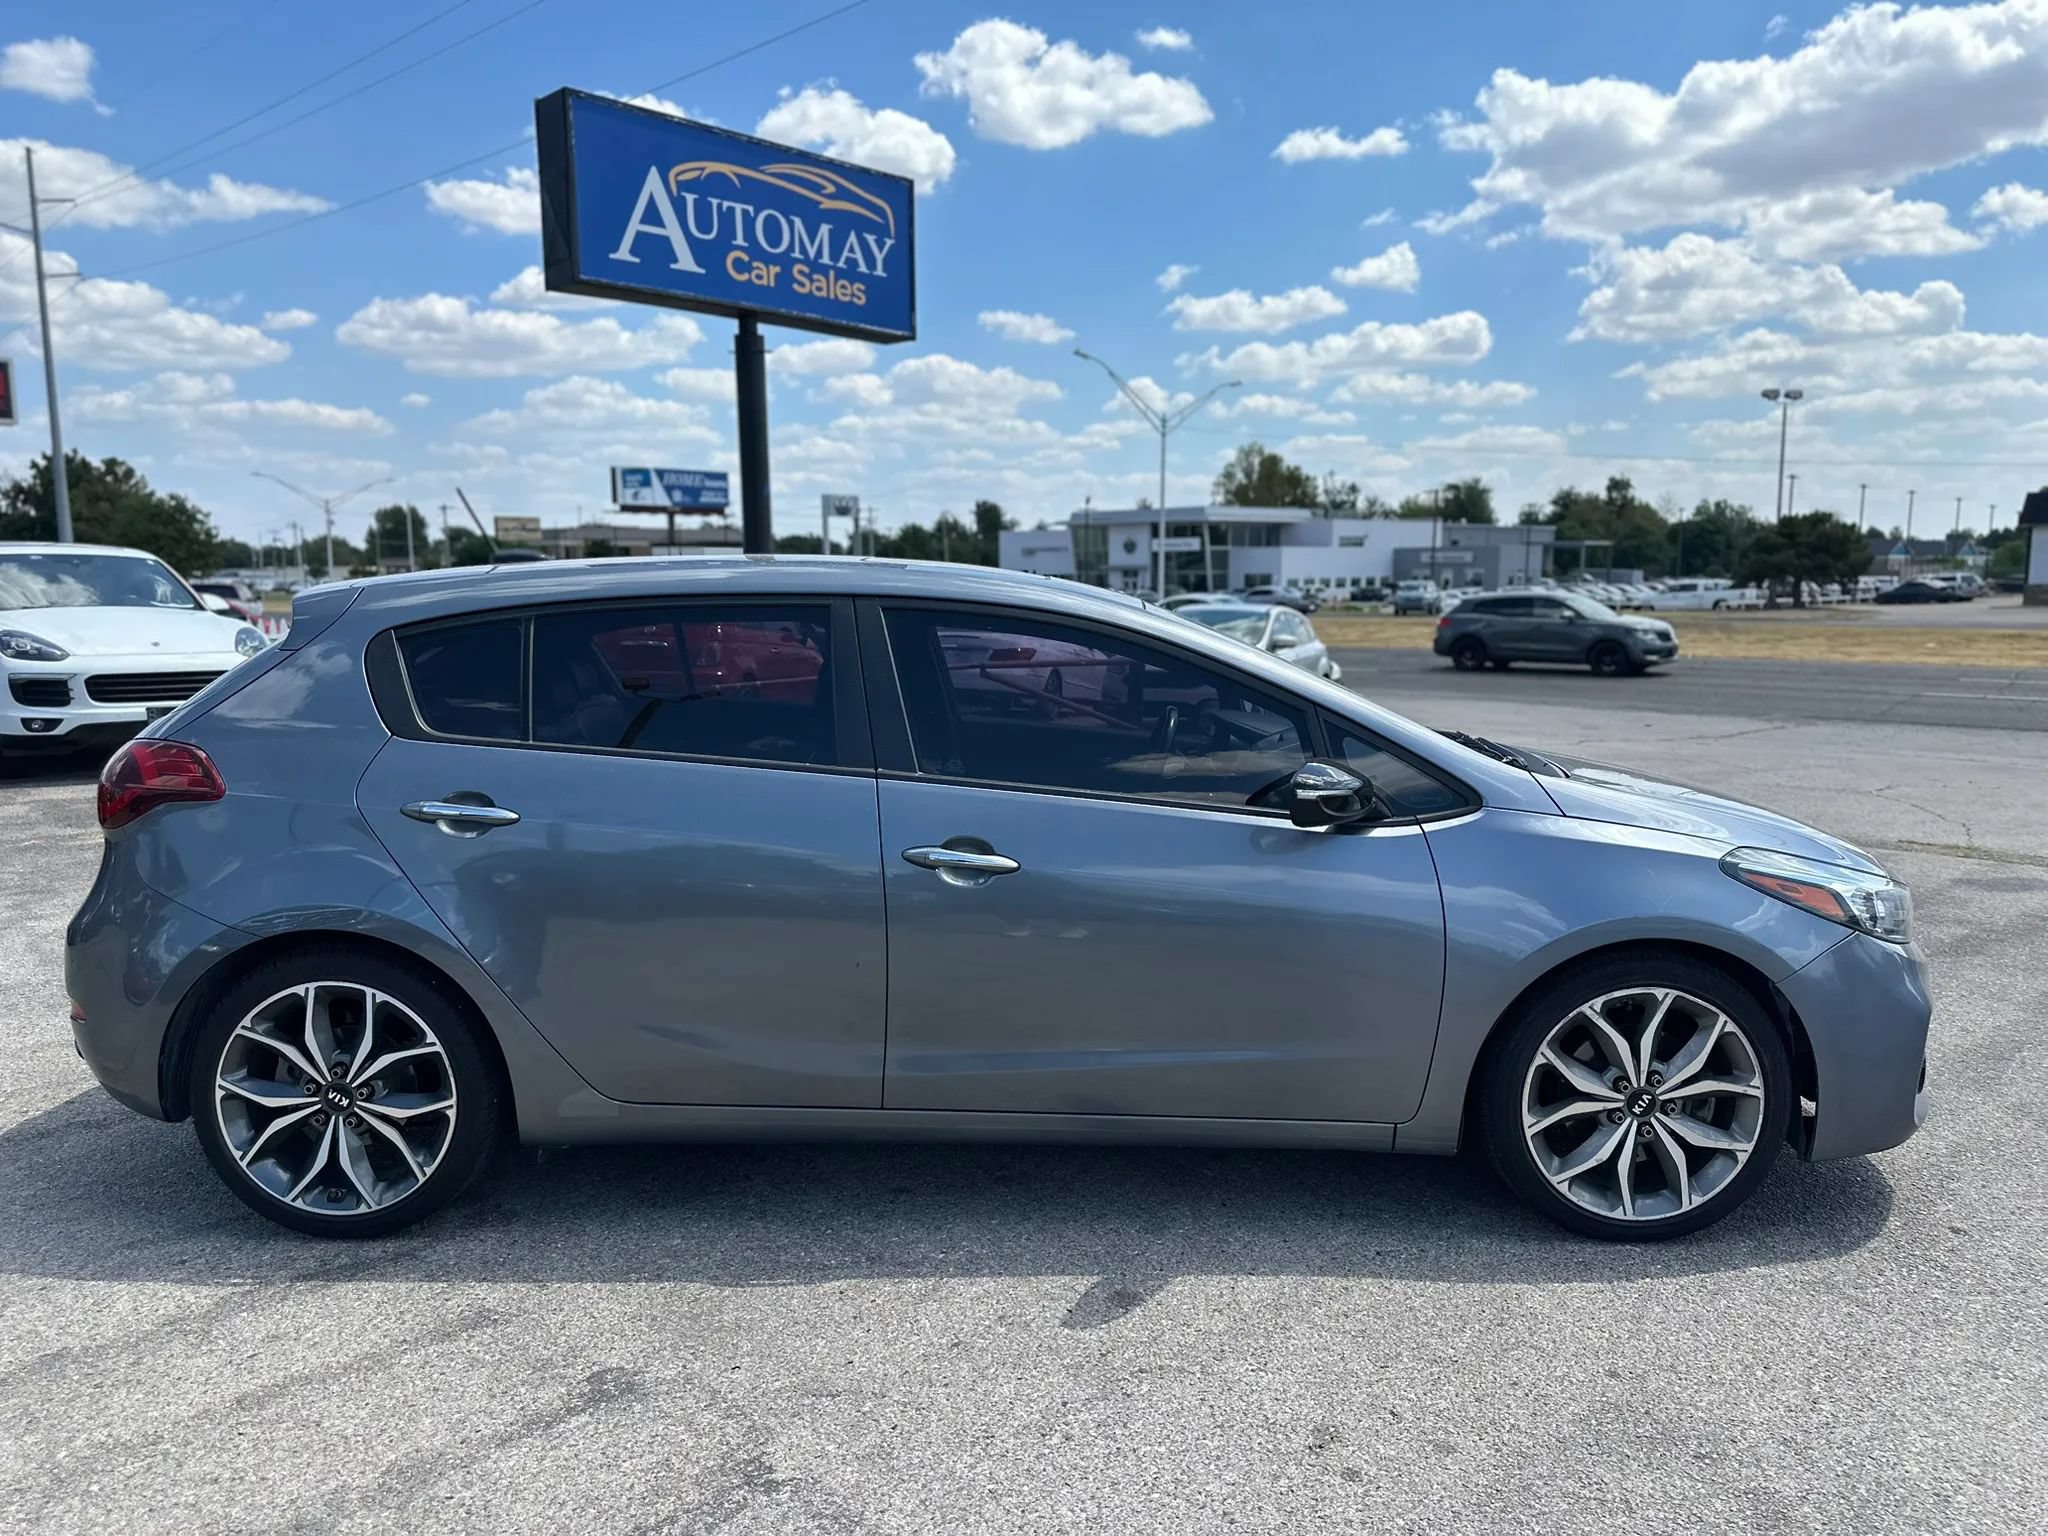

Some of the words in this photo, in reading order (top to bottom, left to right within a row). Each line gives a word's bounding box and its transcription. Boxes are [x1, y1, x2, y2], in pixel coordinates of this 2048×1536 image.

[609, 165, 896, 278] AUTOMAY
[726, 251, 781, 288] Car
[792, 264, 867, 305] Sales
[328, 1089, 350, 1107] KIA
[1632, 1095, 1652, 1115] KIA
